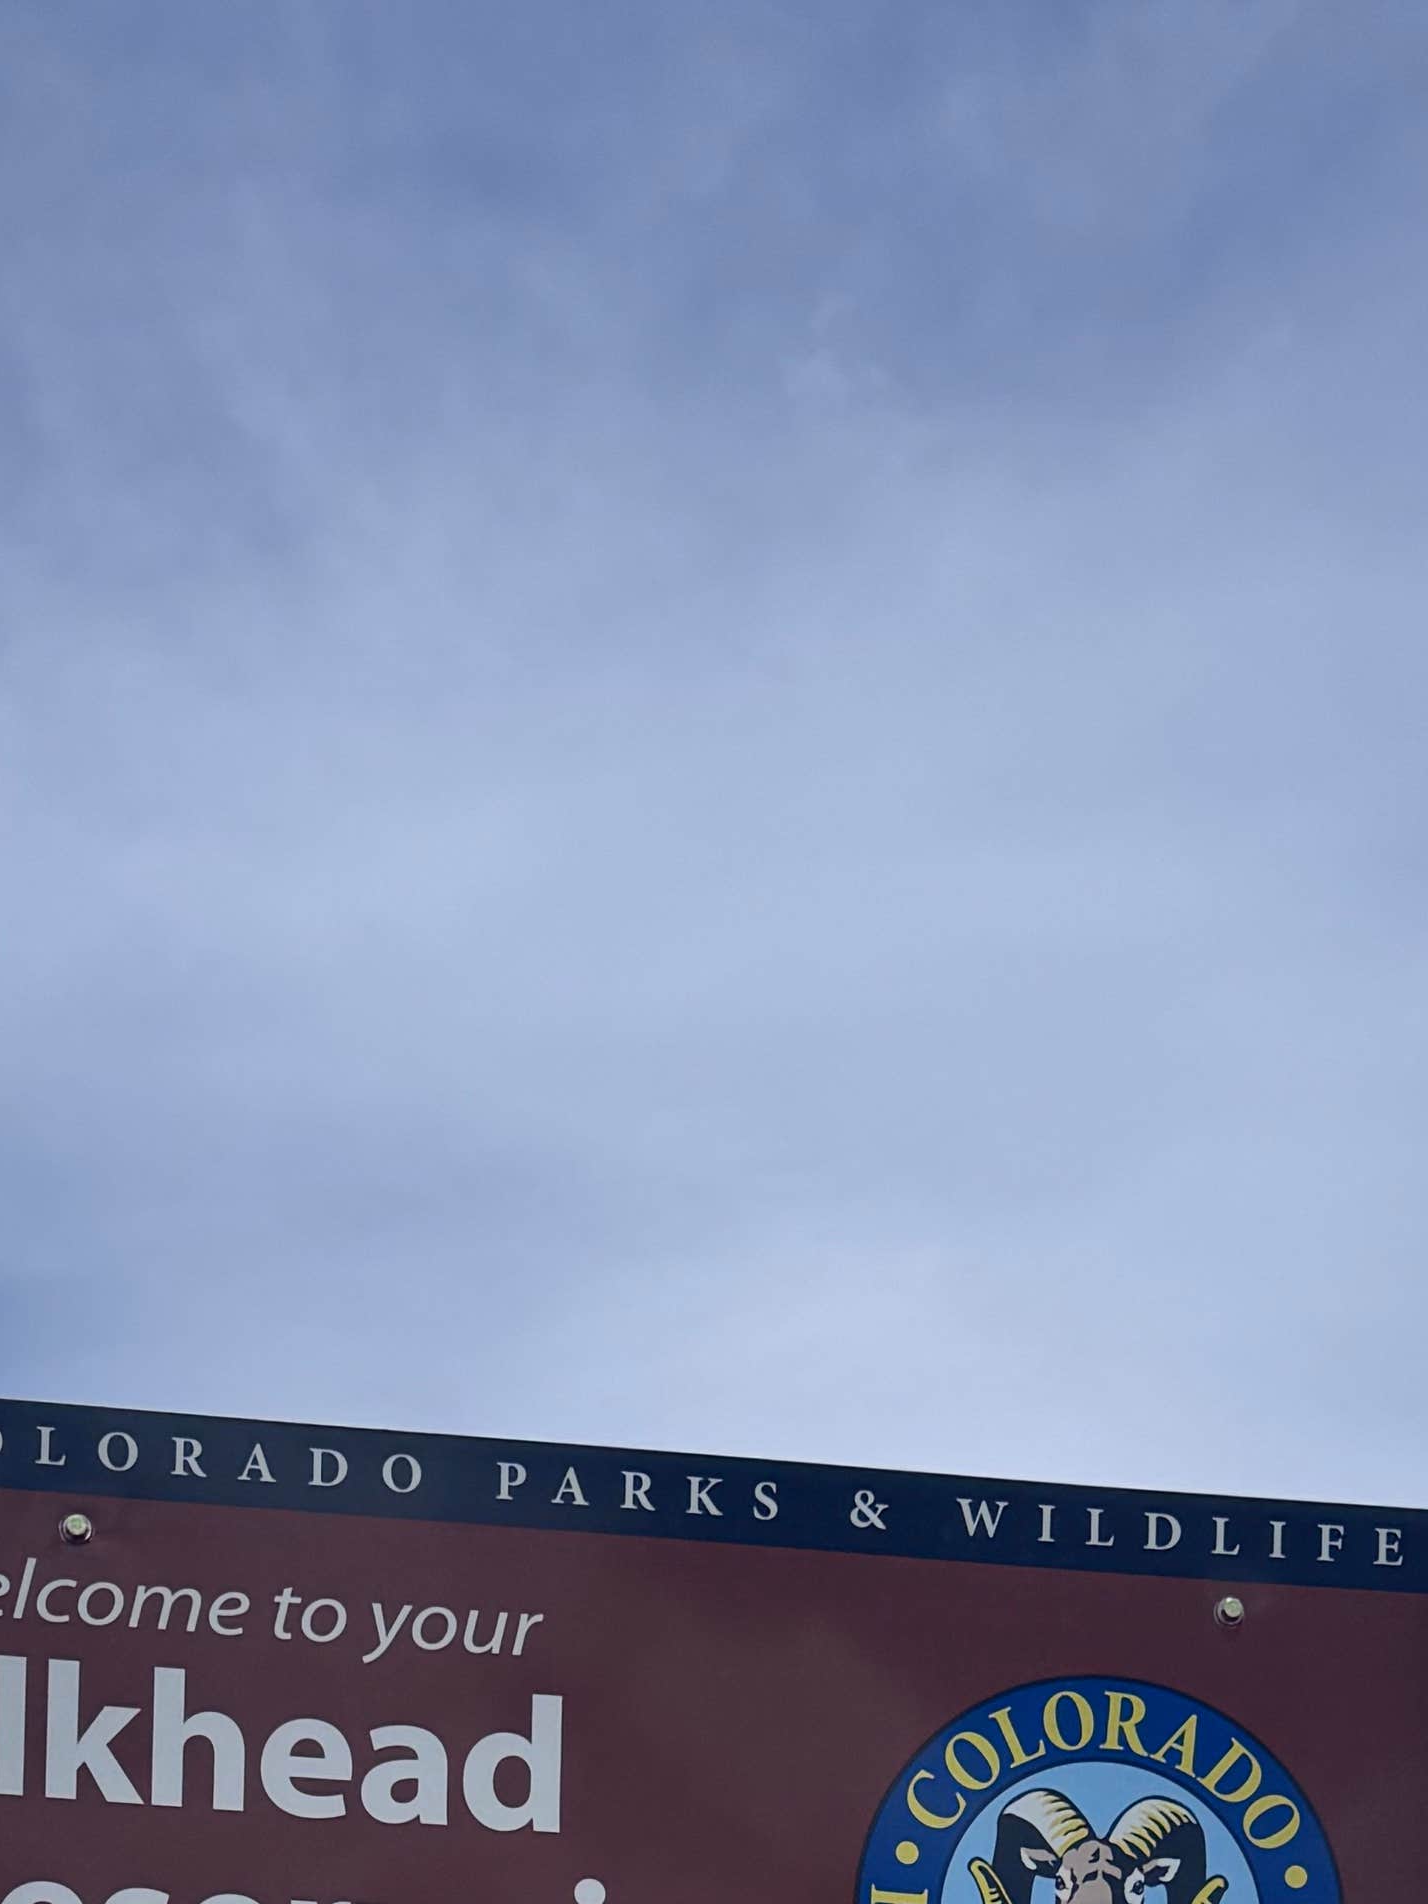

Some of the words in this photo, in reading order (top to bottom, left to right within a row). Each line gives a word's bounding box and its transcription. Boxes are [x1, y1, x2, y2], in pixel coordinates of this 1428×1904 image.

[495, 1461, 779, 1521] PARKS
[849, 1489, 890, 1531] &
[955, 1497, 1404, 1567] WILDLIFE
[272, 1585, 348, 1644] to
[361, 1601, 545, 1665] your
[906, 1690, 1300, 1850] COLORADO
